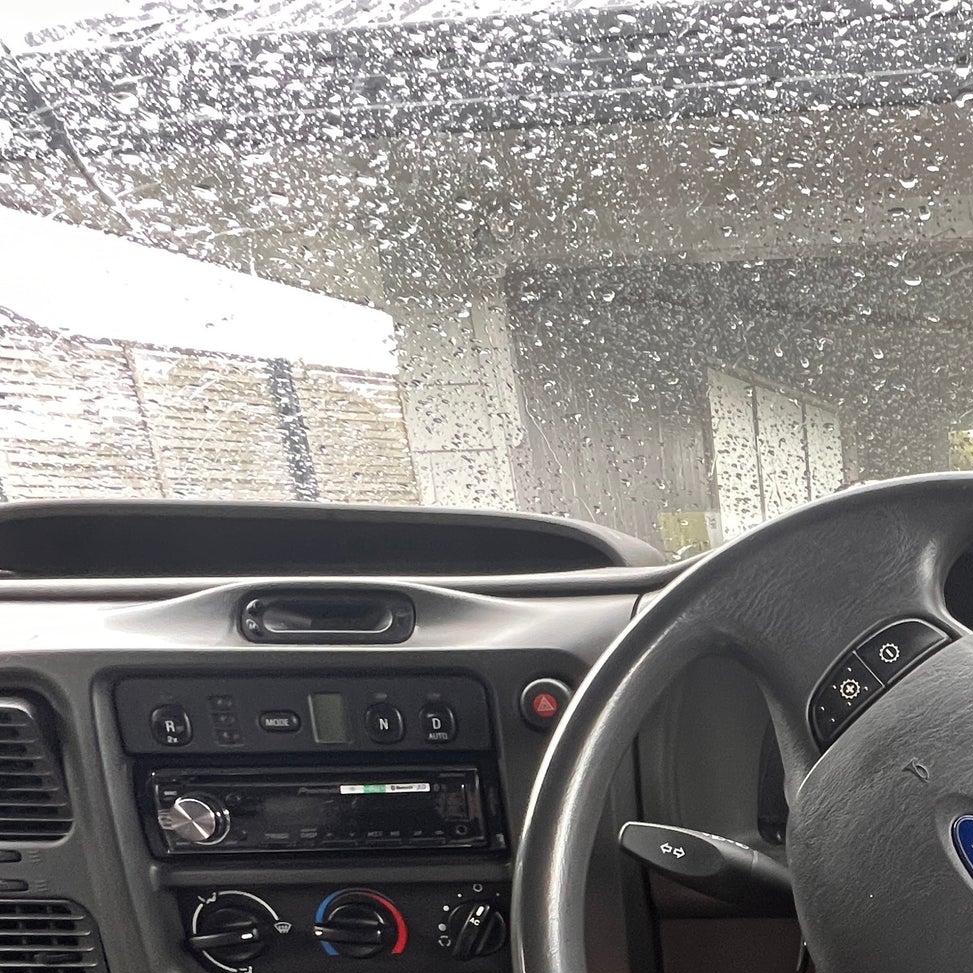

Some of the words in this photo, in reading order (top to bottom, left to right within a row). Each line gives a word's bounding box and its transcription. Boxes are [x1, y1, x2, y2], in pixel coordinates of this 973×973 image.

[165, 720, 176, 732] R
[265, 718, 290, 727] MODE
[379, 718, 389, 730] N
[431, 717, 442, 730] D
[428, 732, 449, 740] AUTO
[469, 917, 480, 926] AC
